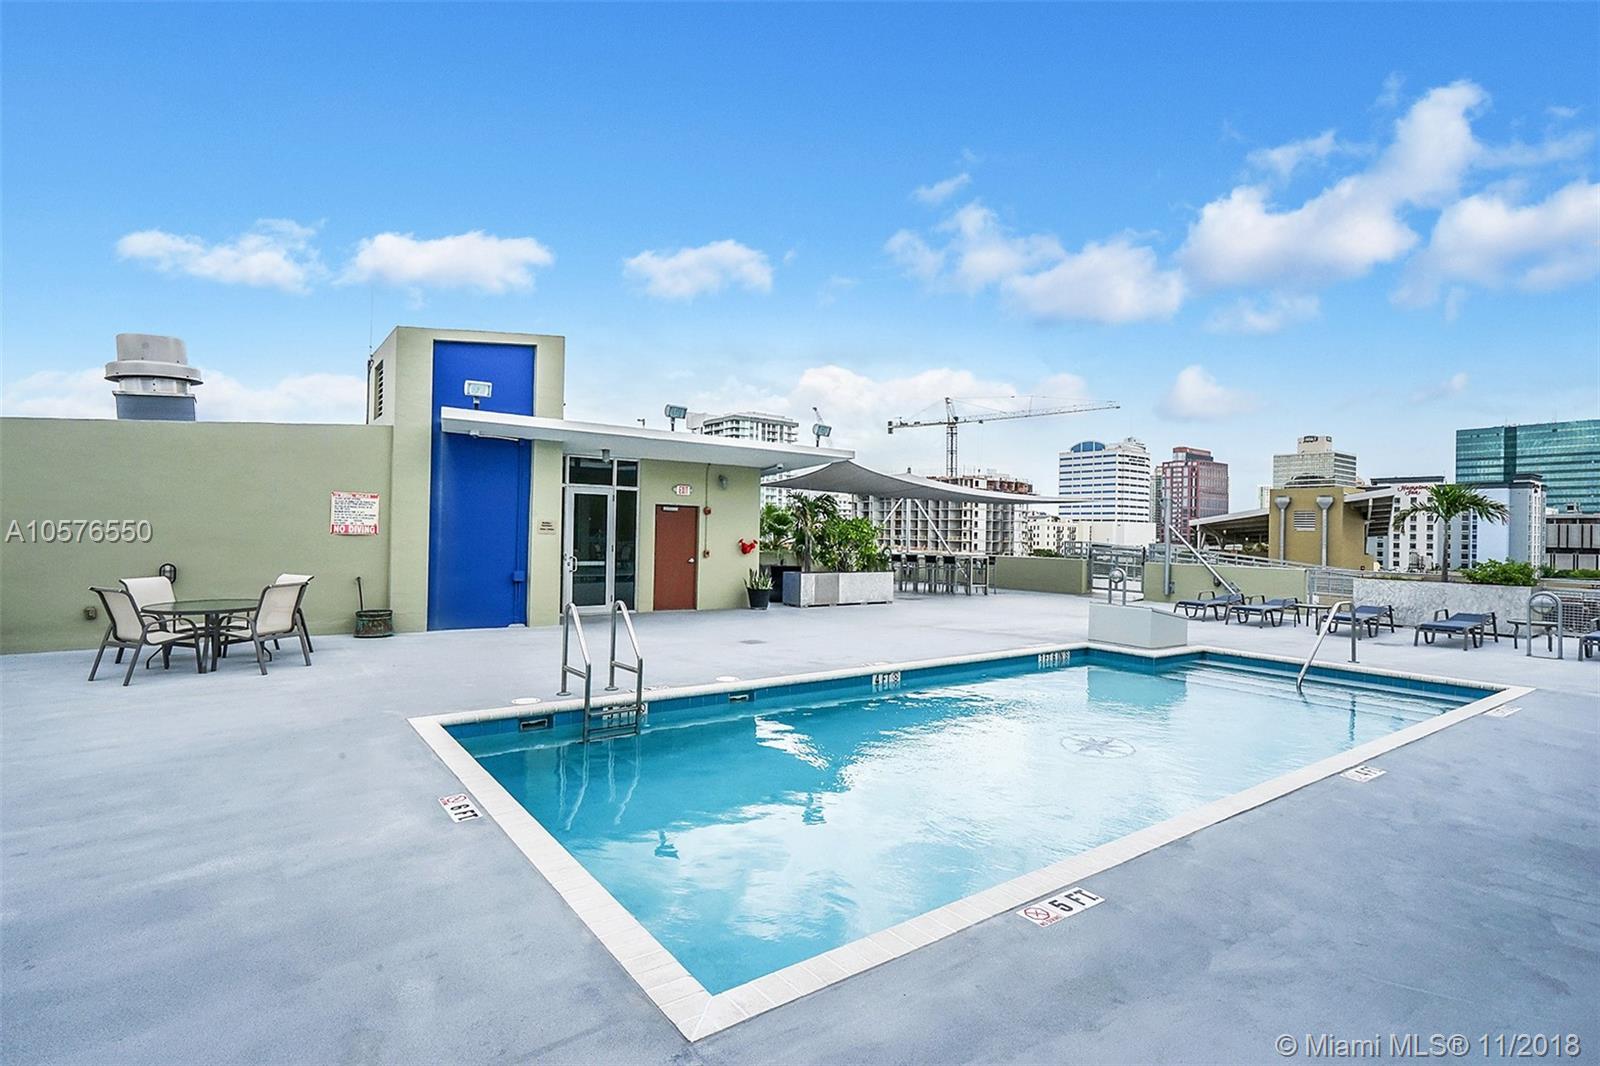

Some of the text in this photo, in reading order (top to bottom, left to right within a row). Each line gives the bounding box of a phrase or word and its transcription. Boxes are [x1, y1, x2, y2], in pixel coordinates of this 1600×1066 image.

[679, 485, 689, 494] EXIT
[333, 525, 376, 534] NO DIVING
[1048, 899, 1074, 912] 5
